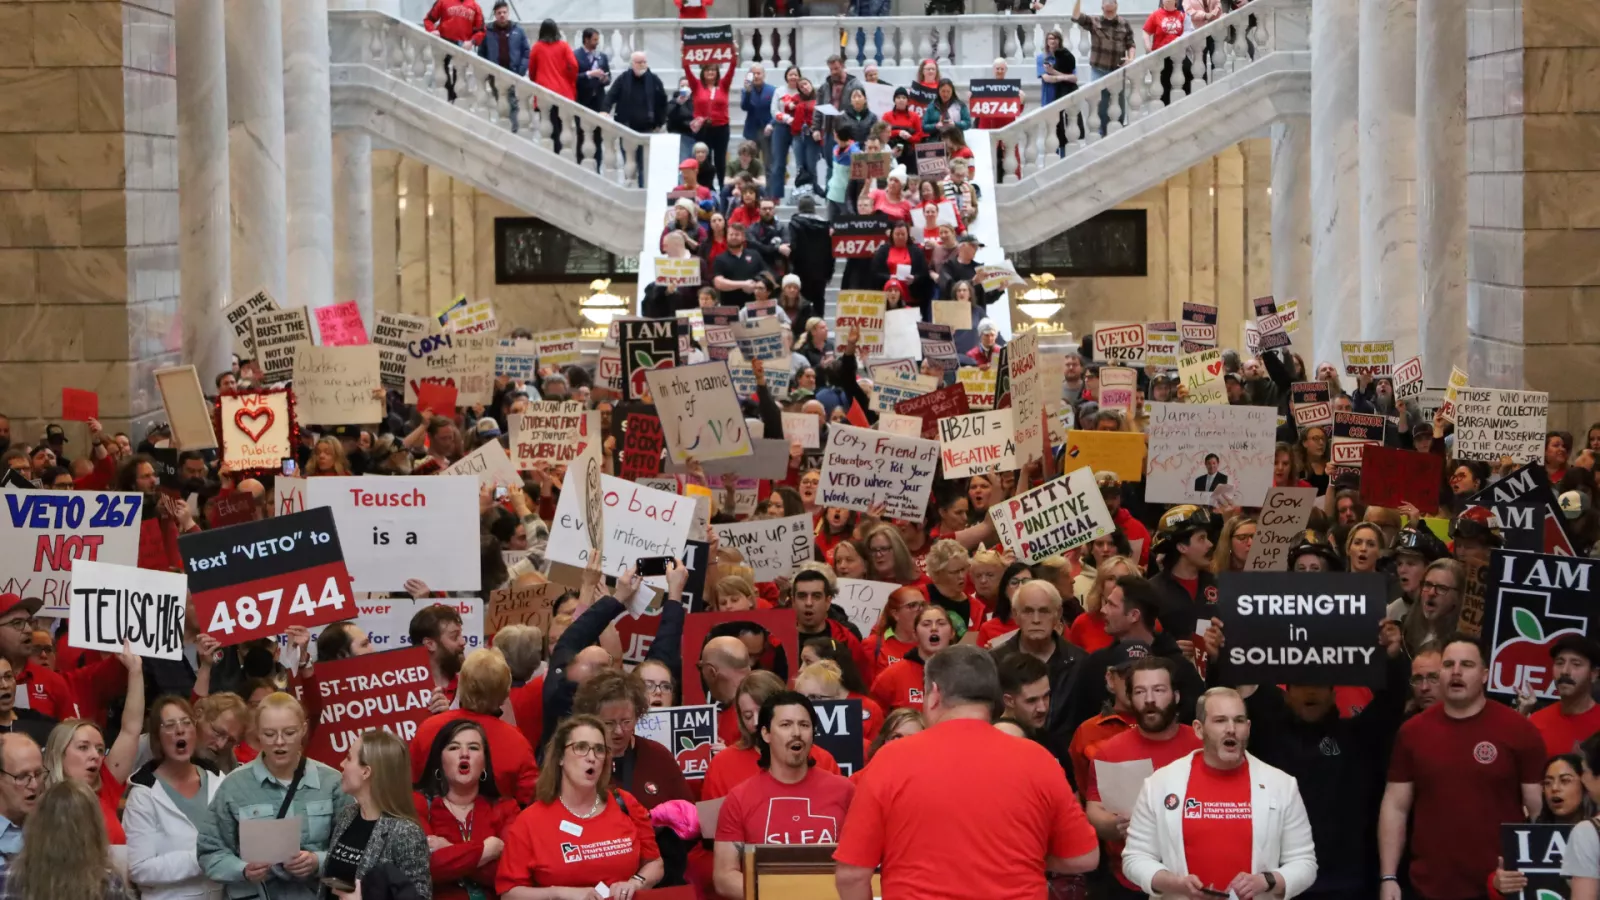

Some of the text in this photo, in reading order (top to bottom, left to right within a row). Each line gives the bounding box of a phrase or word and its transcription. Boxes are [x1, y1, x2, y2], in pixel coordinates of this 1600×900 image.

[698, 31, 723, 40] "VETO"
[685, 47, 733, 62] 48744
[986, 84, 1011, 93] "VETO"
[972, 101, 1018, 115] 48744
[919, 160, 945, 171] VETO
[850, 220, 878, 229] "VETO"
[227, 291, 268, 324] END THE
[256, 320, 305, 338] BUST THE
[376, 325, 403, 339] BUST
[625, 321, 673, 338] I AM
[1099, 329, 1140, 346] VETO
[1184, 327, 1213, 339] VETO
[265, 348, 281, 359] NOT
[1104, 346, 1145, 359] HB267
[379, 361, 406, 374] NION
[659, 382, 668, 397] in
[671, 375, 691, 396] the
[695, 375, 729, 393] name
[1188, 373, 1216, 391] ALL
[241, 395, 269, 407] WE
[685, 398, 699, 417] of
[1500, 393, 1520, 404] WHO
[1523, 394, 1548, 404] WOULD
[1297, 407, 1327, 421] VETO
[1457, 404, 1548, 417] CRIPPLE COLLECTIVE
[628, 416, 661, 433] GOV
[941, 415, 985, 443] HB267
[1335, 413, 1383, 427] GOVERNOR
[1457, 416, 1519, 429] BARGAINING
[1348, 427, 1368, 438] COX
[1457, 430, 1545, 441] DO A DISSERVICE
[626, 433, 660, 453] COX
[833, 429, 867, 450] Cox,
[874, 437, 918, 460] Friend
[920, 447, 936, 463] of
[1458, 441, 1541, 453] TO THE CAUSE OF
[943, 444, 1001, 472] NEGATIVE
[1336, 446, 1363, 459] VET
[625, 454, 656, 470] VETO
[828, 453, 885, 473] Educators?
[828, 471, 860, 488] VETO
[864, 474, 893, 489] where
[350, 488, 426, 507] Teusch
[1008, 476, 1073, 520] PETTY
[4, 493, 142, 530] VETO 267
[627, 488, 677, 527] bad.
[1014, 491, 1090, 540] PUNITIVE
[1262, 511, 1300, 527] Cox:
[373, 526, 418, 545] is a
[613, 524, 677, 557] introverts
[719, 527, 758, 548] Show
[1020, 514, 1098, 558] POLITICAL
[33, 534, 104, 573] NOT
[189, 531, 331, 572] text "VETO" to
[745, 545, 765, 556] for
[1263, 548, 1281, 558] up
[1252, 556, 1278, 570] for
[1500, 555, 1592, 591] I AM
[496, 584, 548, 604] Stand
[846, 584, 874, 602] TO
[207, 576, 346, 635] 48744
[1237, 595, 1366, 616] STRENGTH
[73, 587, 186, 654] TEUSCHER
[368, 632, 390, 644] for
[1289, 623, 1308, 642] in
[1229, 647, 1376, 665] SOLIDARITY
[320, 688, 433, 725] NPOPULAR
[674, 711, 710, 729] I AM
[581, 841, 613, 849] TOGETHER,
[1514, 830, 1533, 863] I
